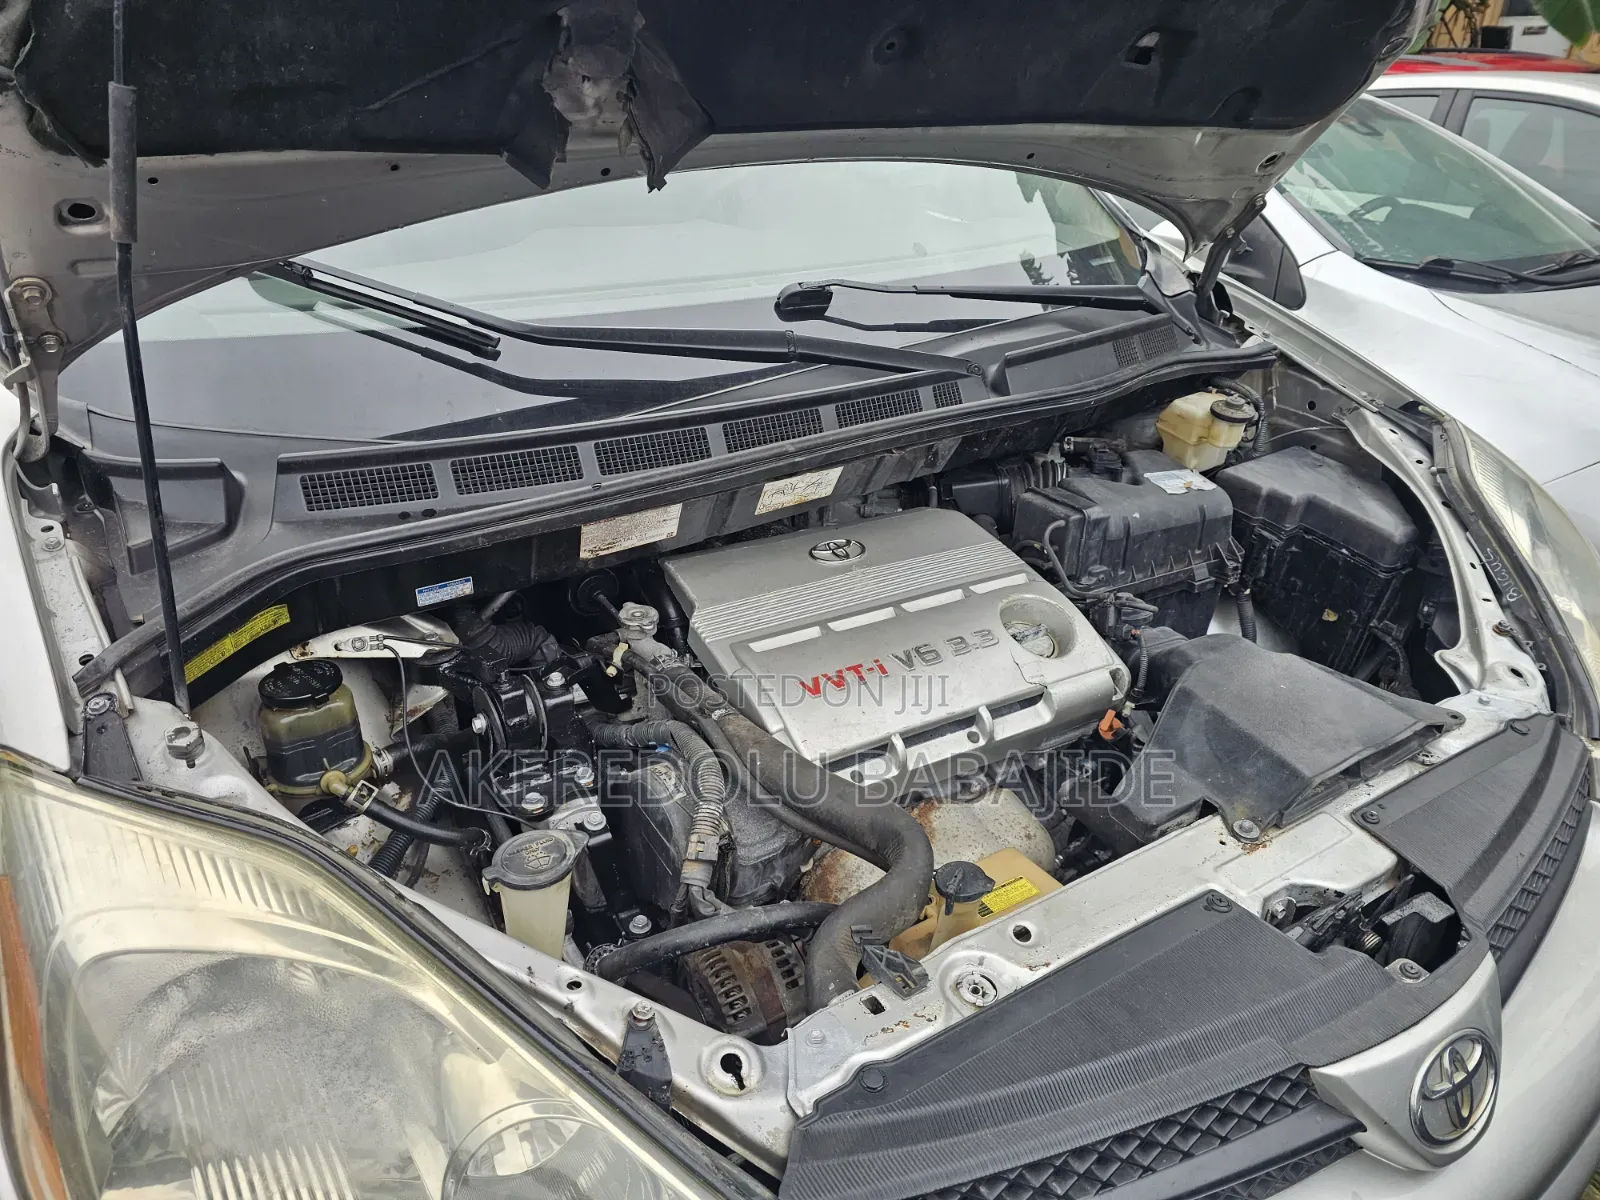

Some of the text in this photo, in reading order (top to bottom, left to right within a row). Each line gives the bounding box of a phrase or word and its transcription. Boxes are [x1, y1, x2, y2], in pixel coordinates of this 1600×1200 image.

[798, 628, 1000, 698] VVT-i V6 3.3
[536, 837, 554, 847] FLUID
[525, 847, 539, 855] ONLY
